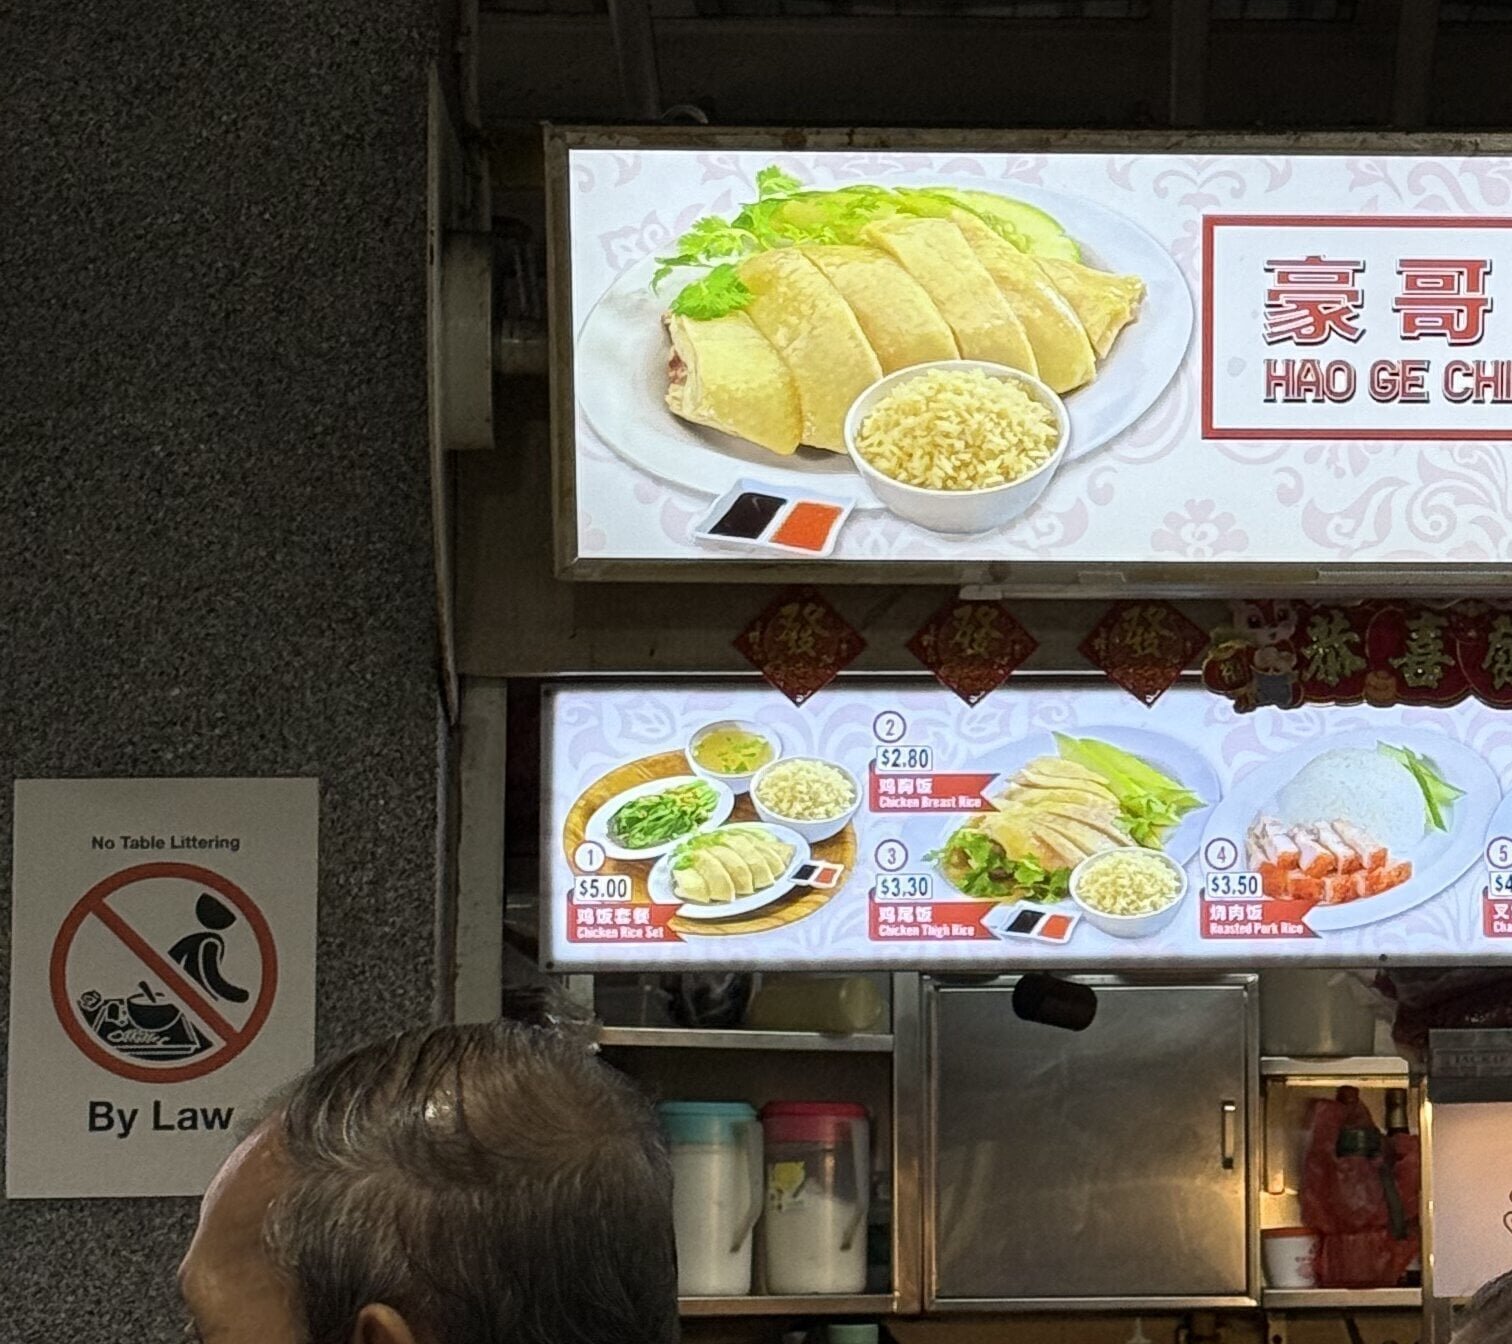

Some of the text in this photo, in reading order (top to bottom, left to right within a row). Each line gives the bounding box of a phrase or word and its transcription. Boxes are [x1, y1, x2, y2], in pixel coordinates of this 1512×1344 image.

[1264, 359, 1357, 405] HAO
[1368, 359, 1431, 404] GE
[881, 748, 929, 768] $2.80
[879, 796, 982, 808] Chicken Breast Rice
[92, 834, 241, 852] No Table Littering
[580, 878, 628, 898] $5.00
[881, 877, 929, 897] $3.30
[1212, 876, 1258, 895] $3.50
[576, 926, 665, 939] Chicken Rice Set
[879, 924, 975, 938] Chicken Thigh Rice
[1209, 922, 1304, 935] Roasted Pork Rice
[88, 1100, 235, 1138] By Law
